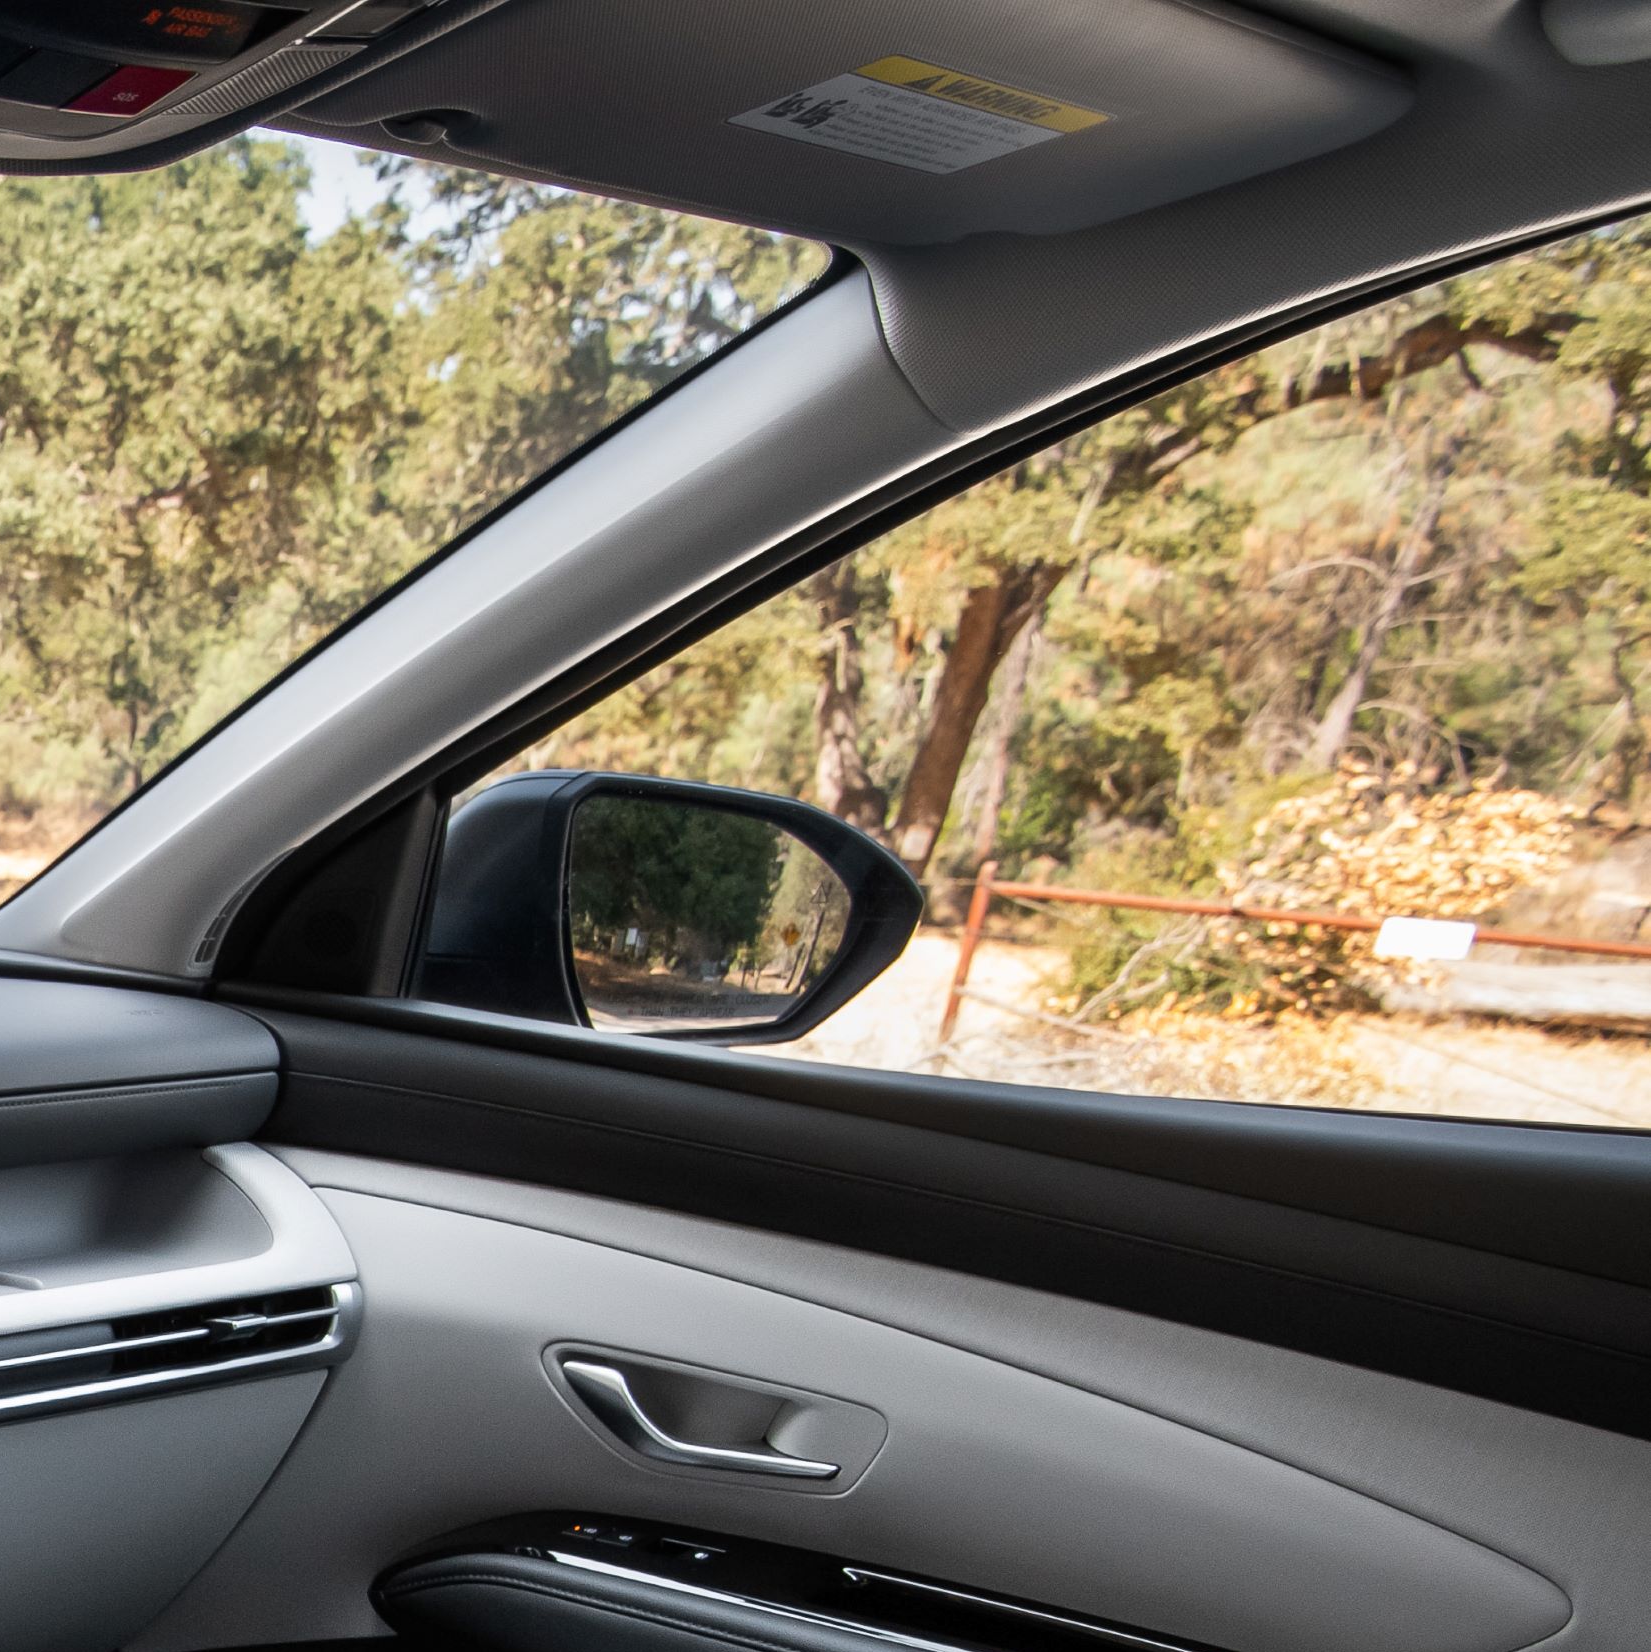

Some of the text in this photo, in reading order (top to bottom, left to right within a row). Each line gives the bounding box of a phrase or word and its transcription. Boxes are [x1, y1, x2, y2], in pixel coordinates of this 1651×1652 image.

[936, 78, 1061, 120] WARNING
[641, 1007, 735, 1017] THAN THEY APPEAR
